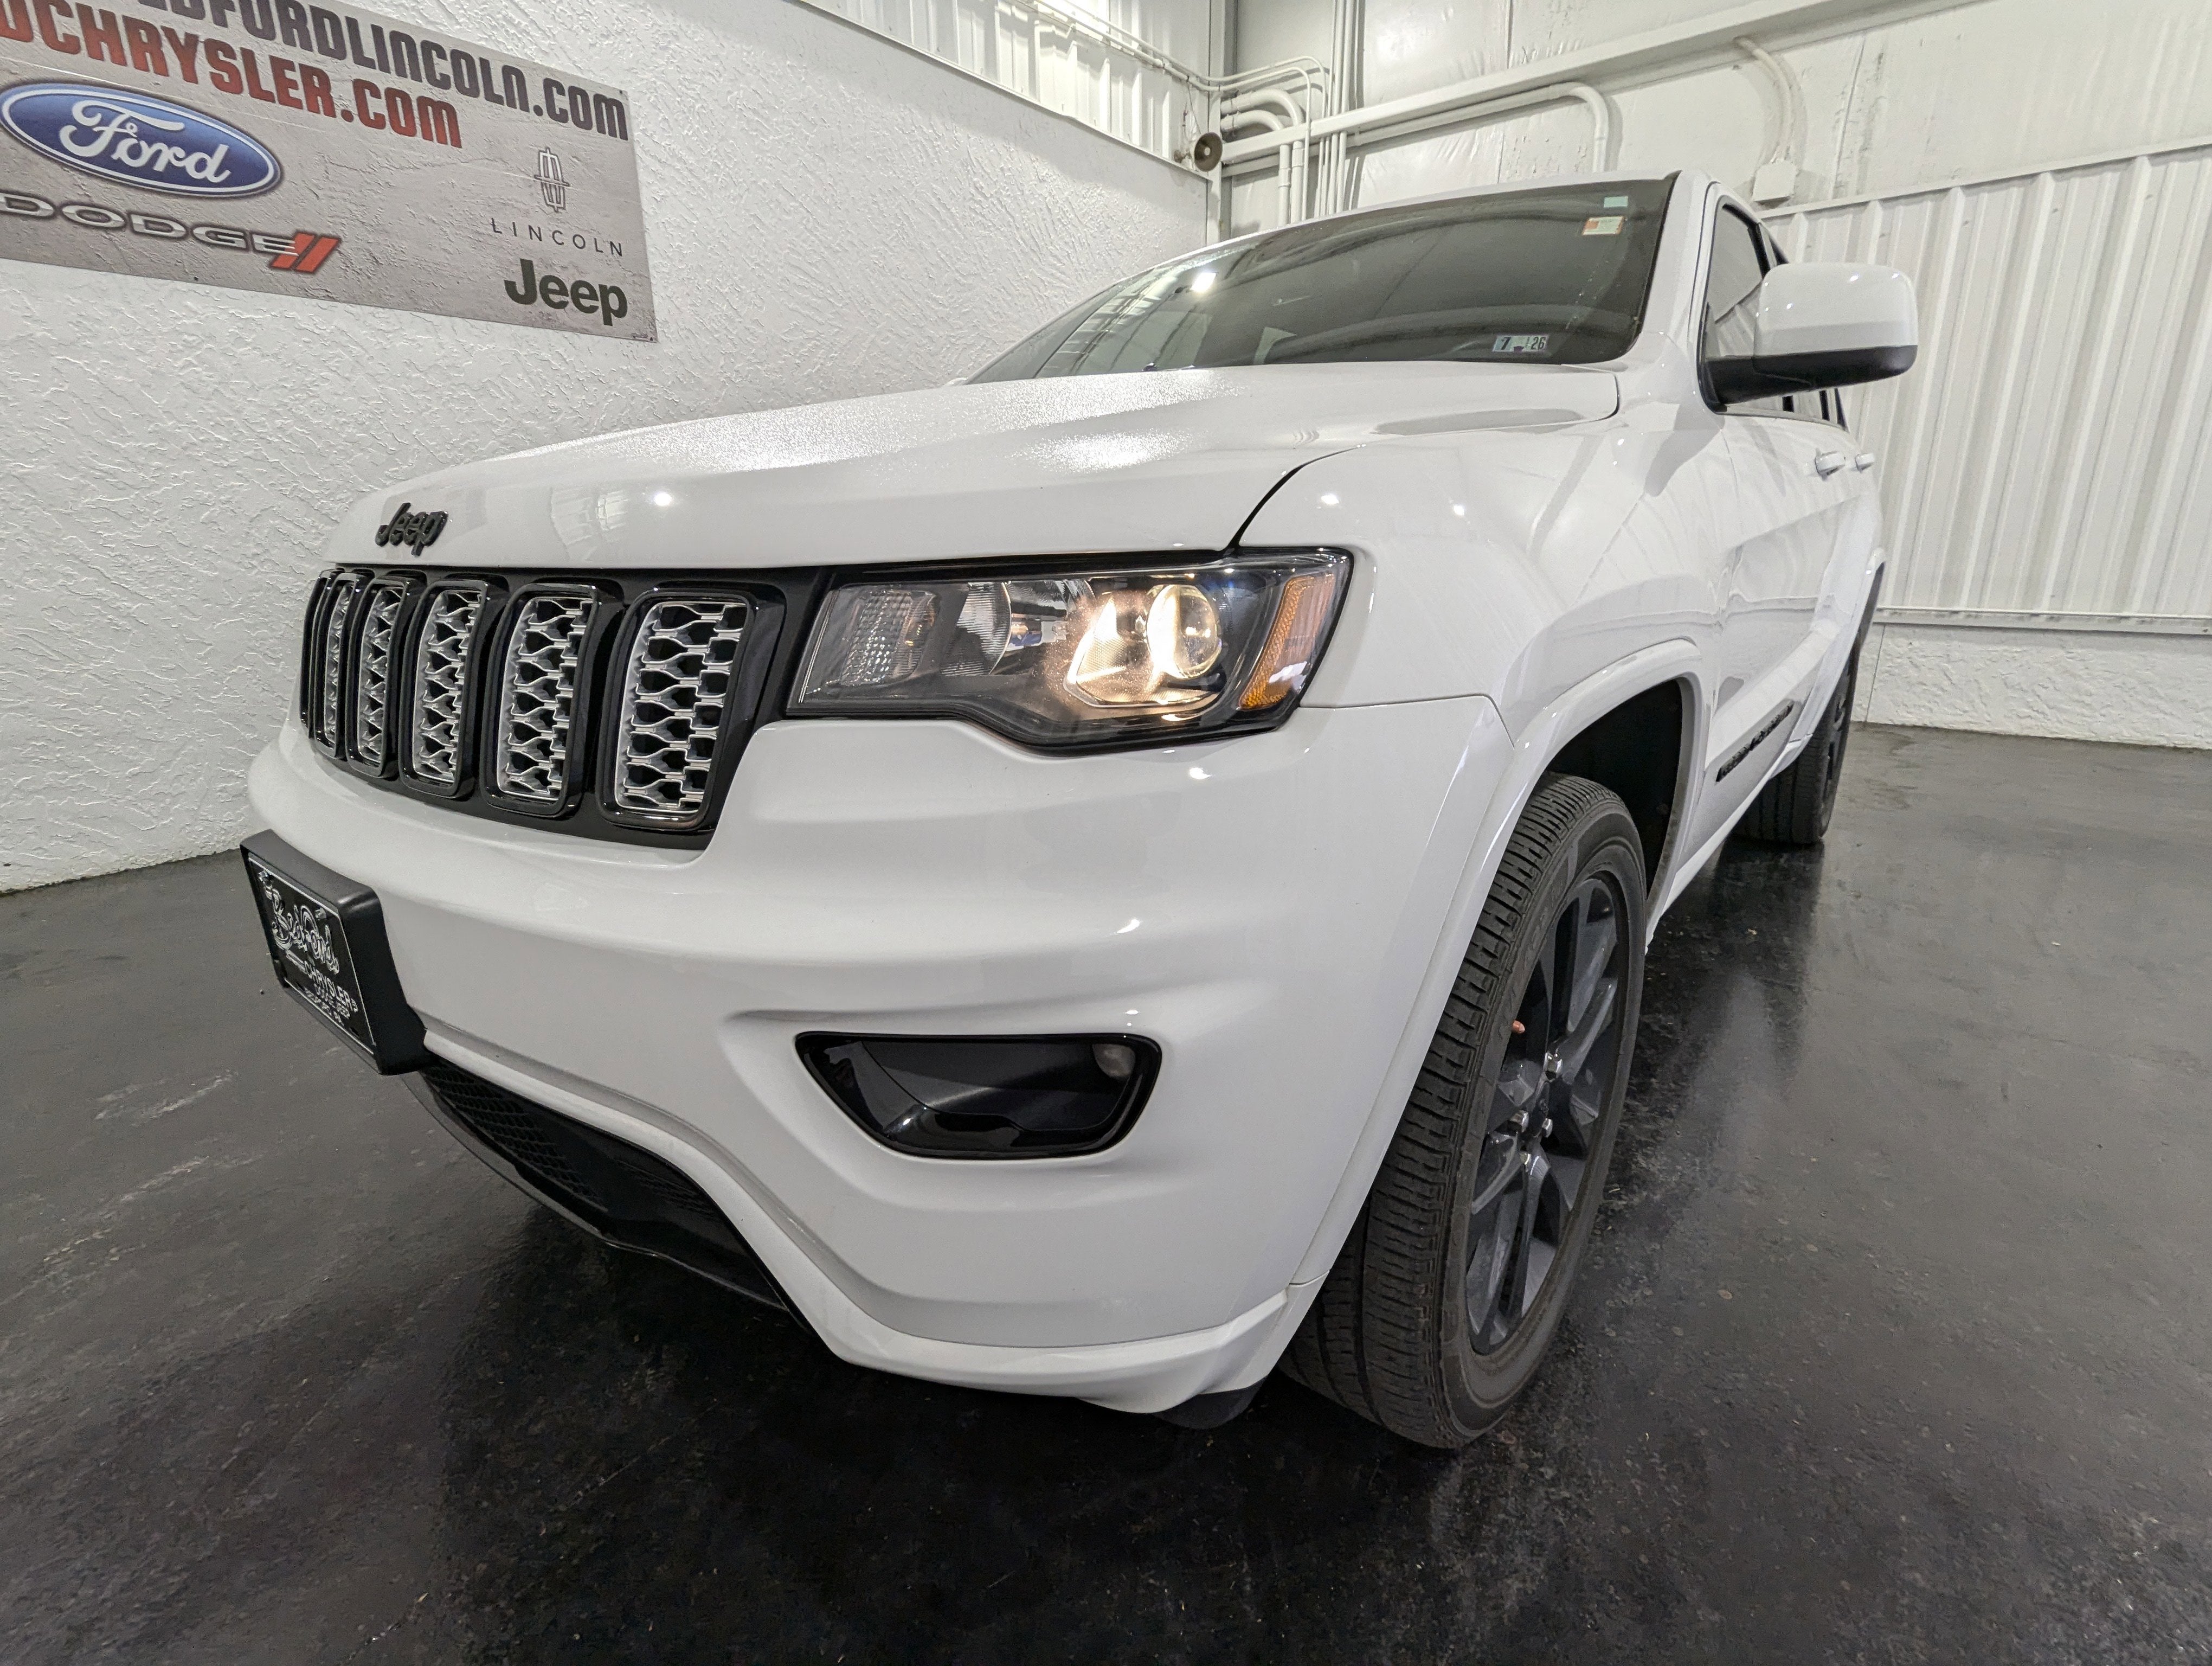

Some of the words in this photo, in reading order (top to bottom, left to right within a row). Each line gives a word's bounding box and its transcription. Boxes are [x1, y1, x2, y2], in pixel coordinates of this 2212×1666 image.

[59, 99, 231, 183] Ford
[0, 192, 299, 257] DODGE
[490, 217, 623, 257] LINCOLN
[504, 258, 628, 325] Jeep
[1501, 336, 1512, 350] 7
[1531, 336, 1546, 350] 26
[375, 502, 449, 556] Jeep
[304, 960, 353, 1011] CHRYSLER
